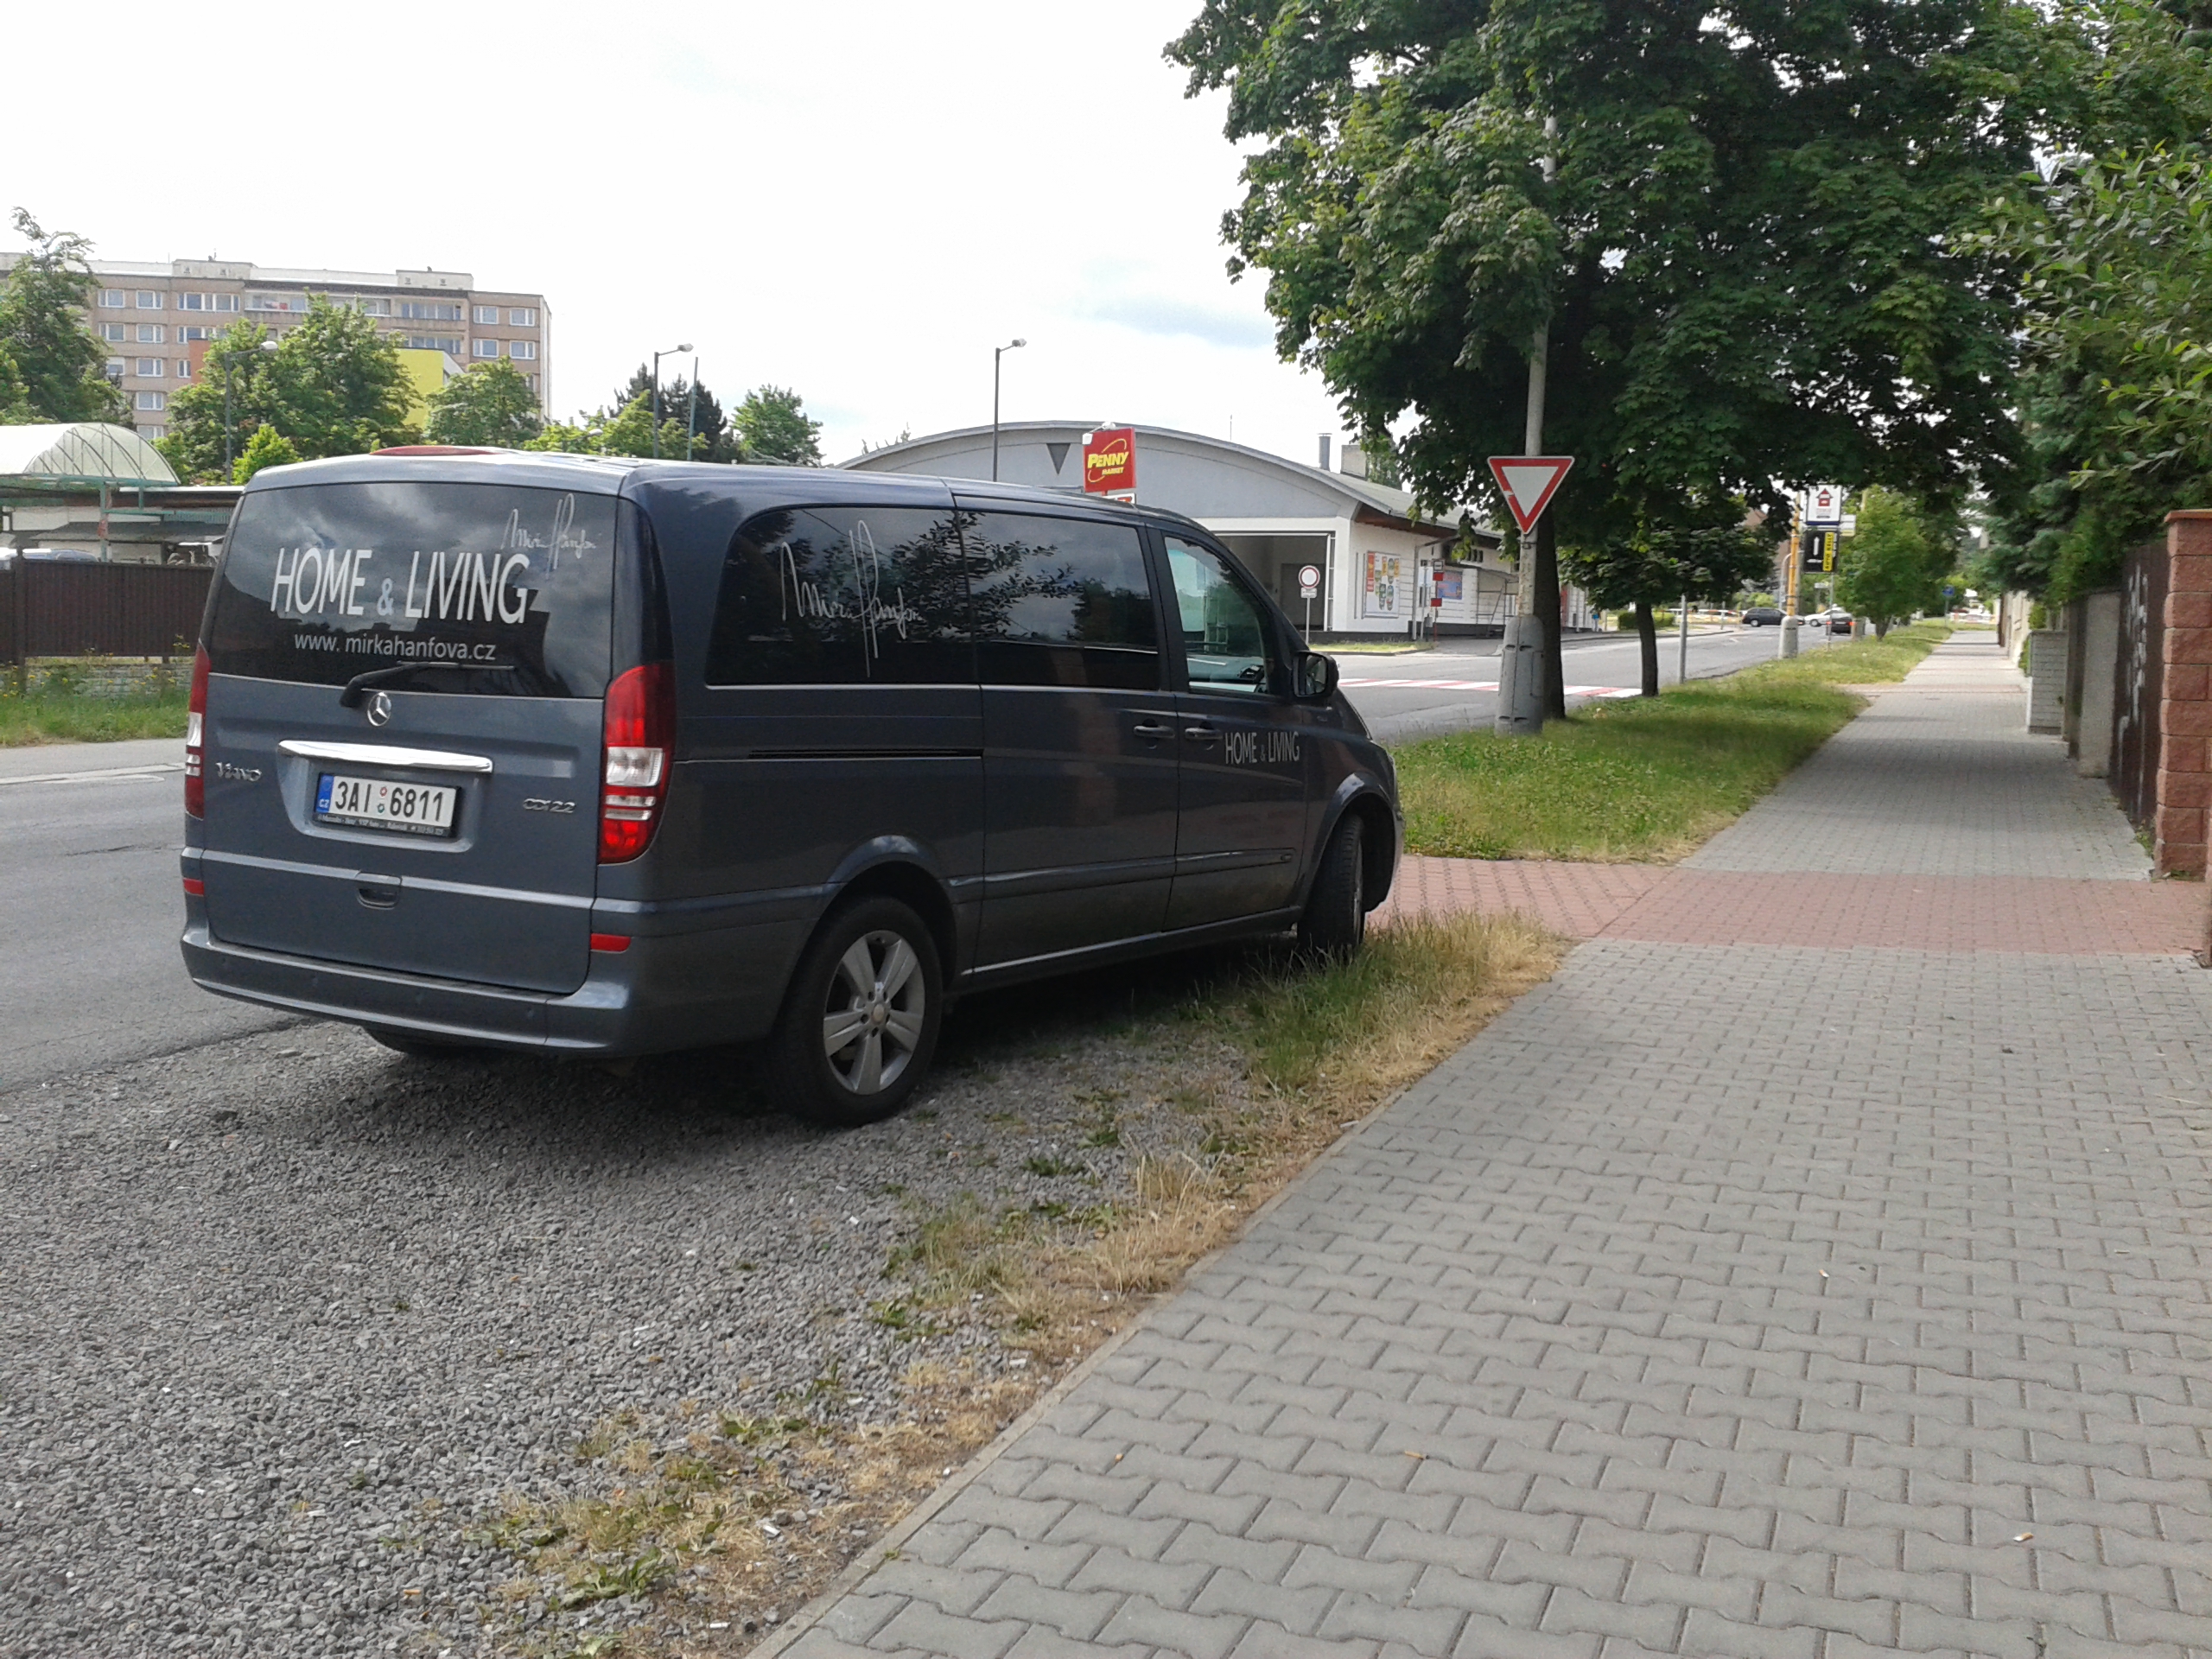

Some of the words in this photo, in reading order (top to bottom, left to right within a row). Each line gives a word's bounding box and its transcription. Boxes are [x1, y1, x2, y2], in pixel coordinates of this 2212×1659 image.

[1087, 451, 1129, 468] PENNY
[270, 547, 372, 616] HOME
[377, 577, 394, 616] &
[404, 550, 531, 624] LIVING
[346, 633, 497, 661] mirkahanfova.cz
[1225, 732, 1258, 764] HOME
[1259, 744, 1267, 762] &
[1268, 731, 1300, 763] LIVING
[319, 798, 330, 809] CZ
[334, 781, 372, 813] 3AI
[390, 787, 444, 822] 6811
